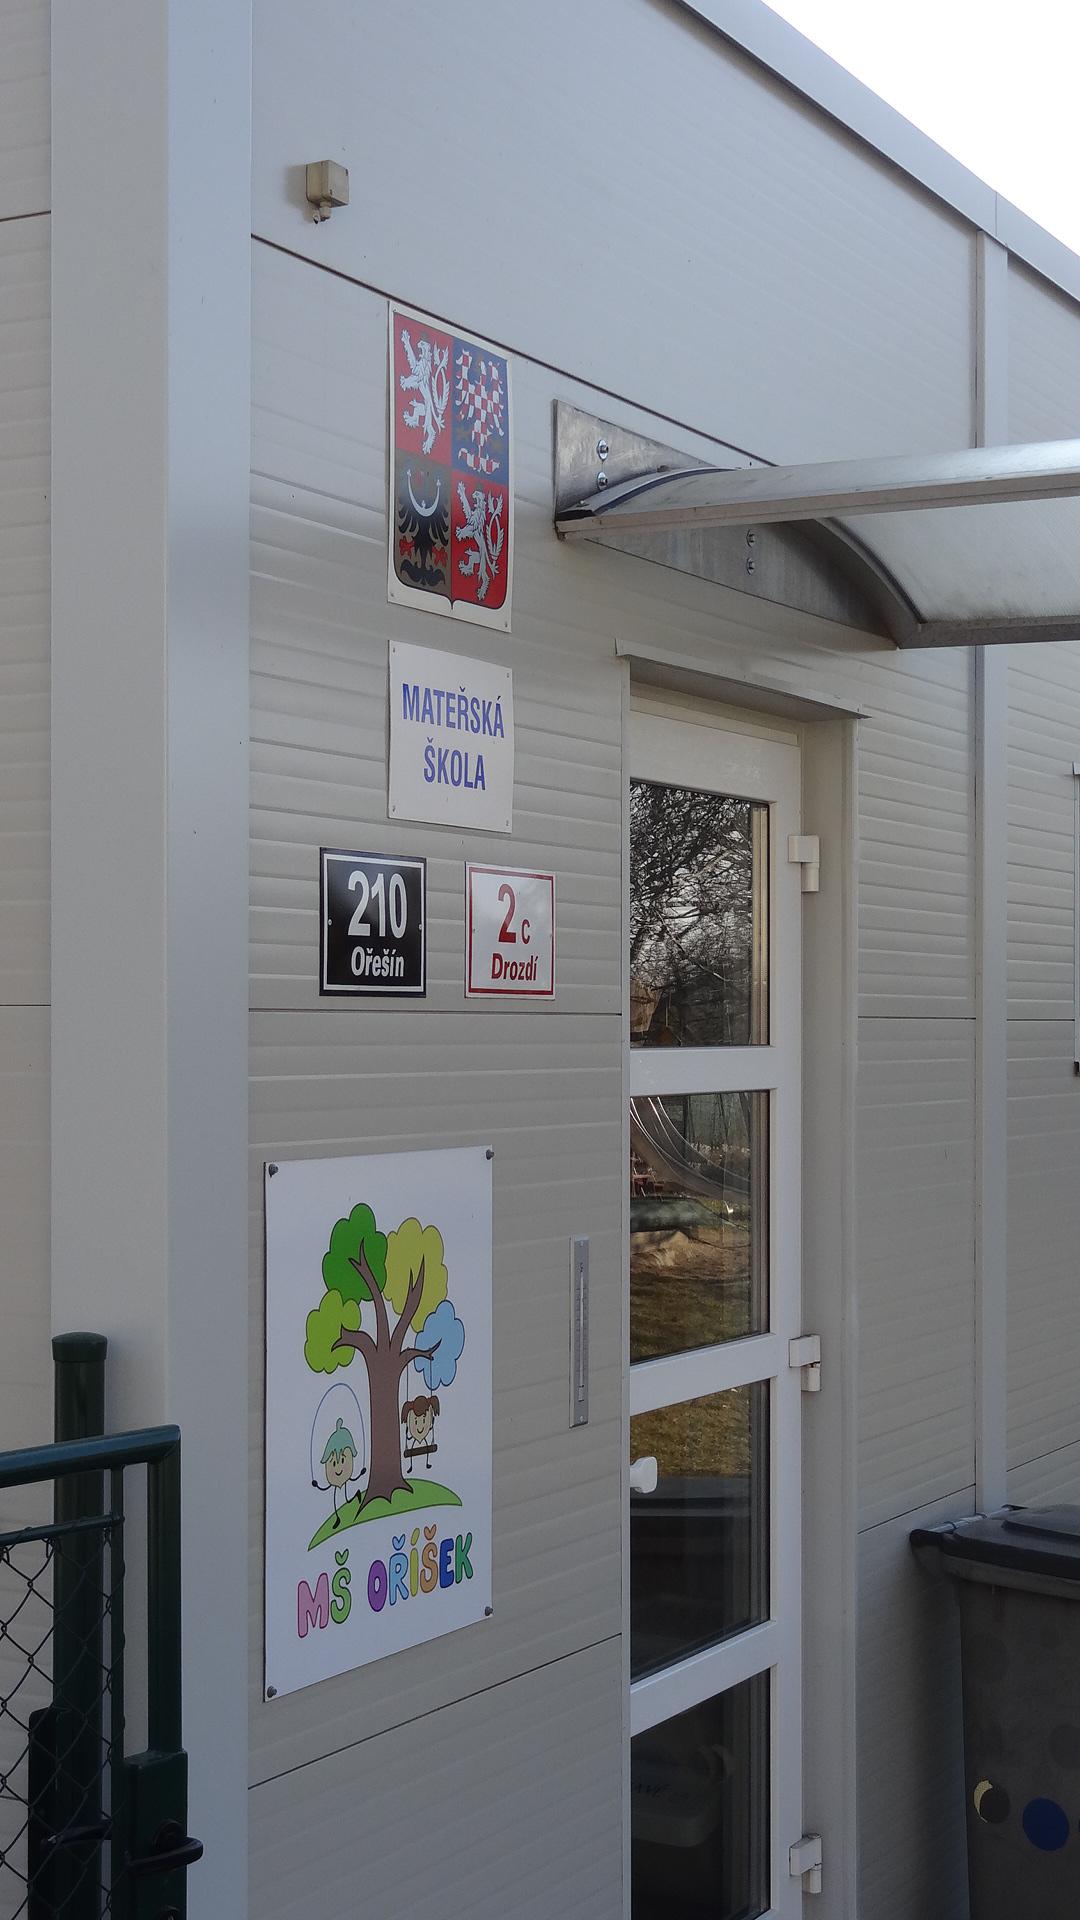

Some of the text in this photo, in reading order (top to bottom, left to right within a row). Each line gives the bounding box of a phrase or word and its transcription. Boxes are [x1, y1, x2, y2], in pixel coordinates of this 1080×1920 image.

[402, 683, 504, 738] MATEŘSKÁ
[424, 737, 485, 790] ŠKOLA
[348, 870, 408, 939] 210
[351, 946, 405, 977] Ořešín
[491, 952, 539, 981] Drozdí
[298, 1524, 474, 1639] MŠ OŘÍŠEK
